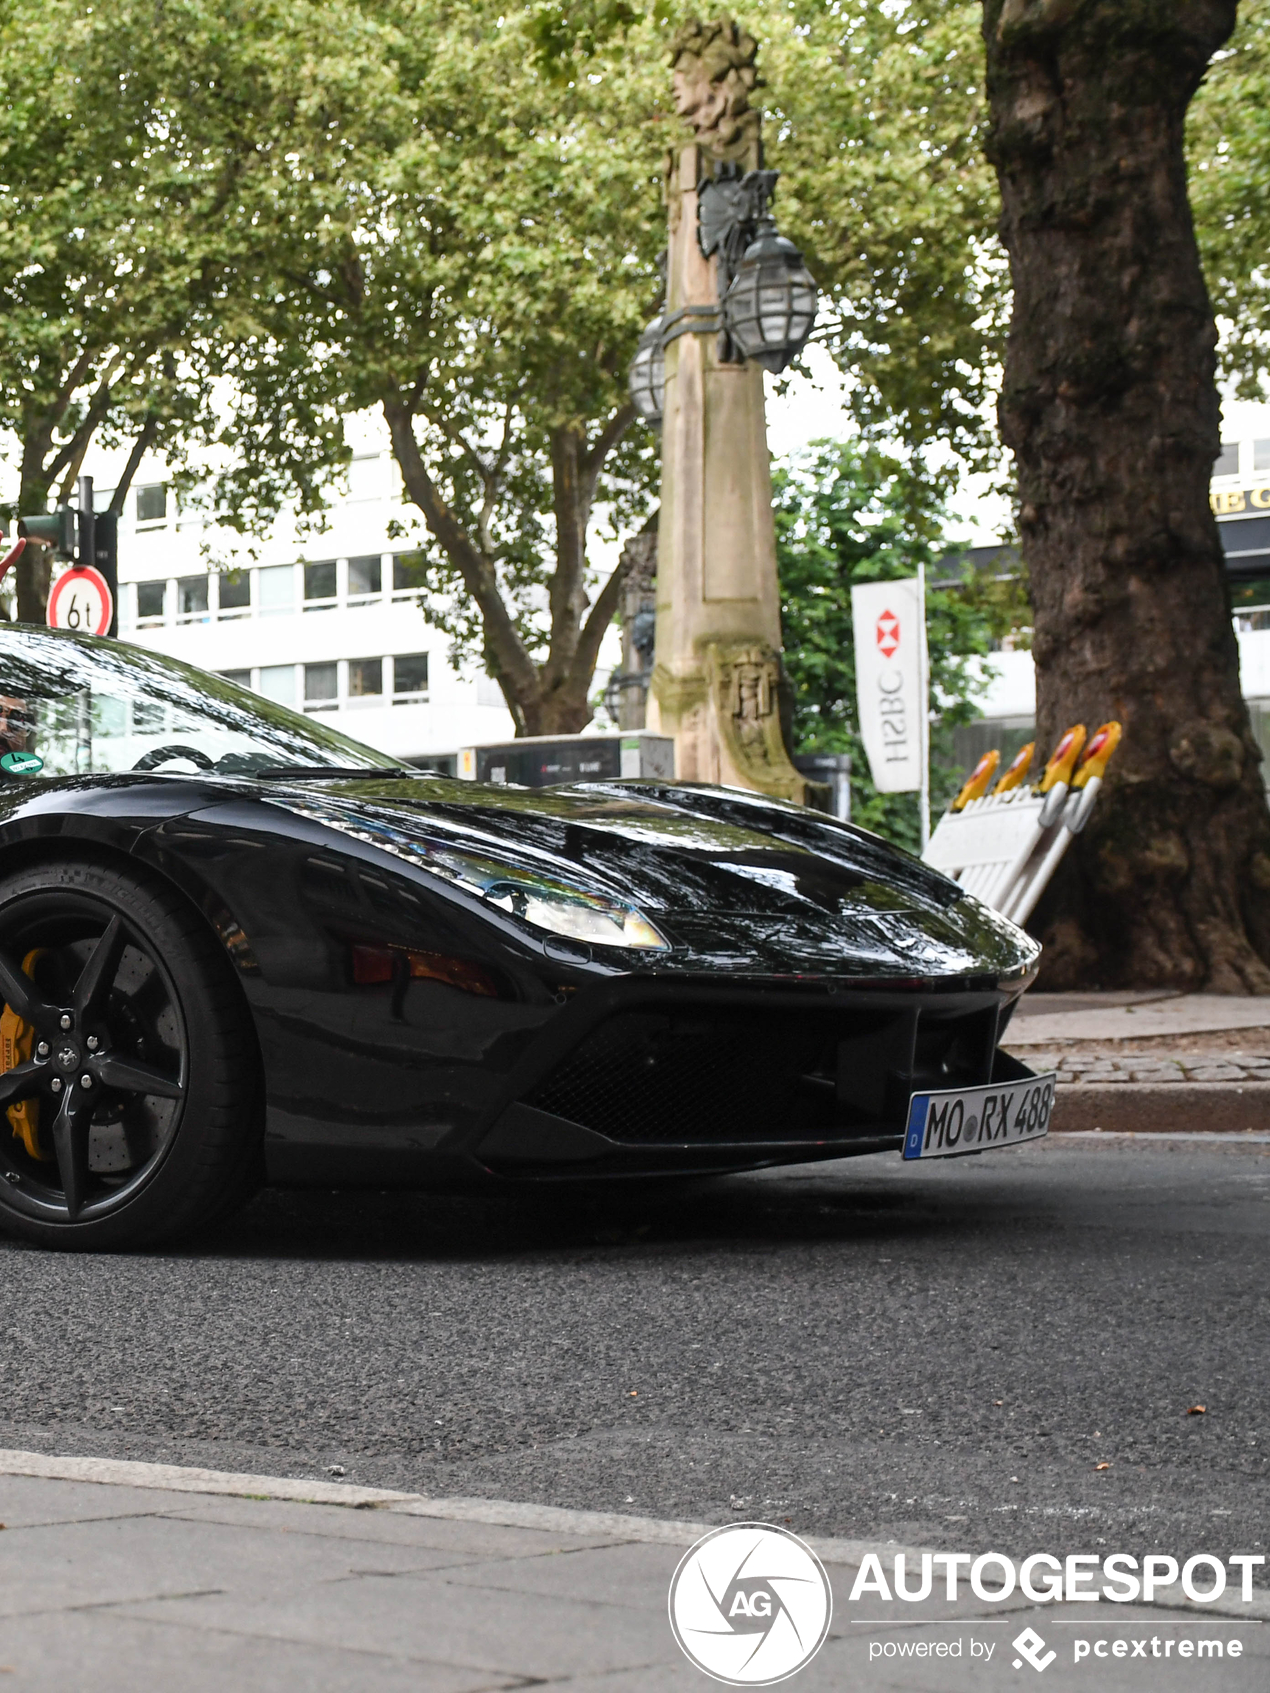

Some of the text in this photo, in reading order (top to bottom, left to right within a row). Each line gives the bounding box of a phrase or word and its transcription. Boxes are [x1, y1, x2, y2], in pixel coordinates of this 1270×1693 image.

[924, 1083, 1052, 1150] MO RX 488
[910, 1133, 918, 1148] D
